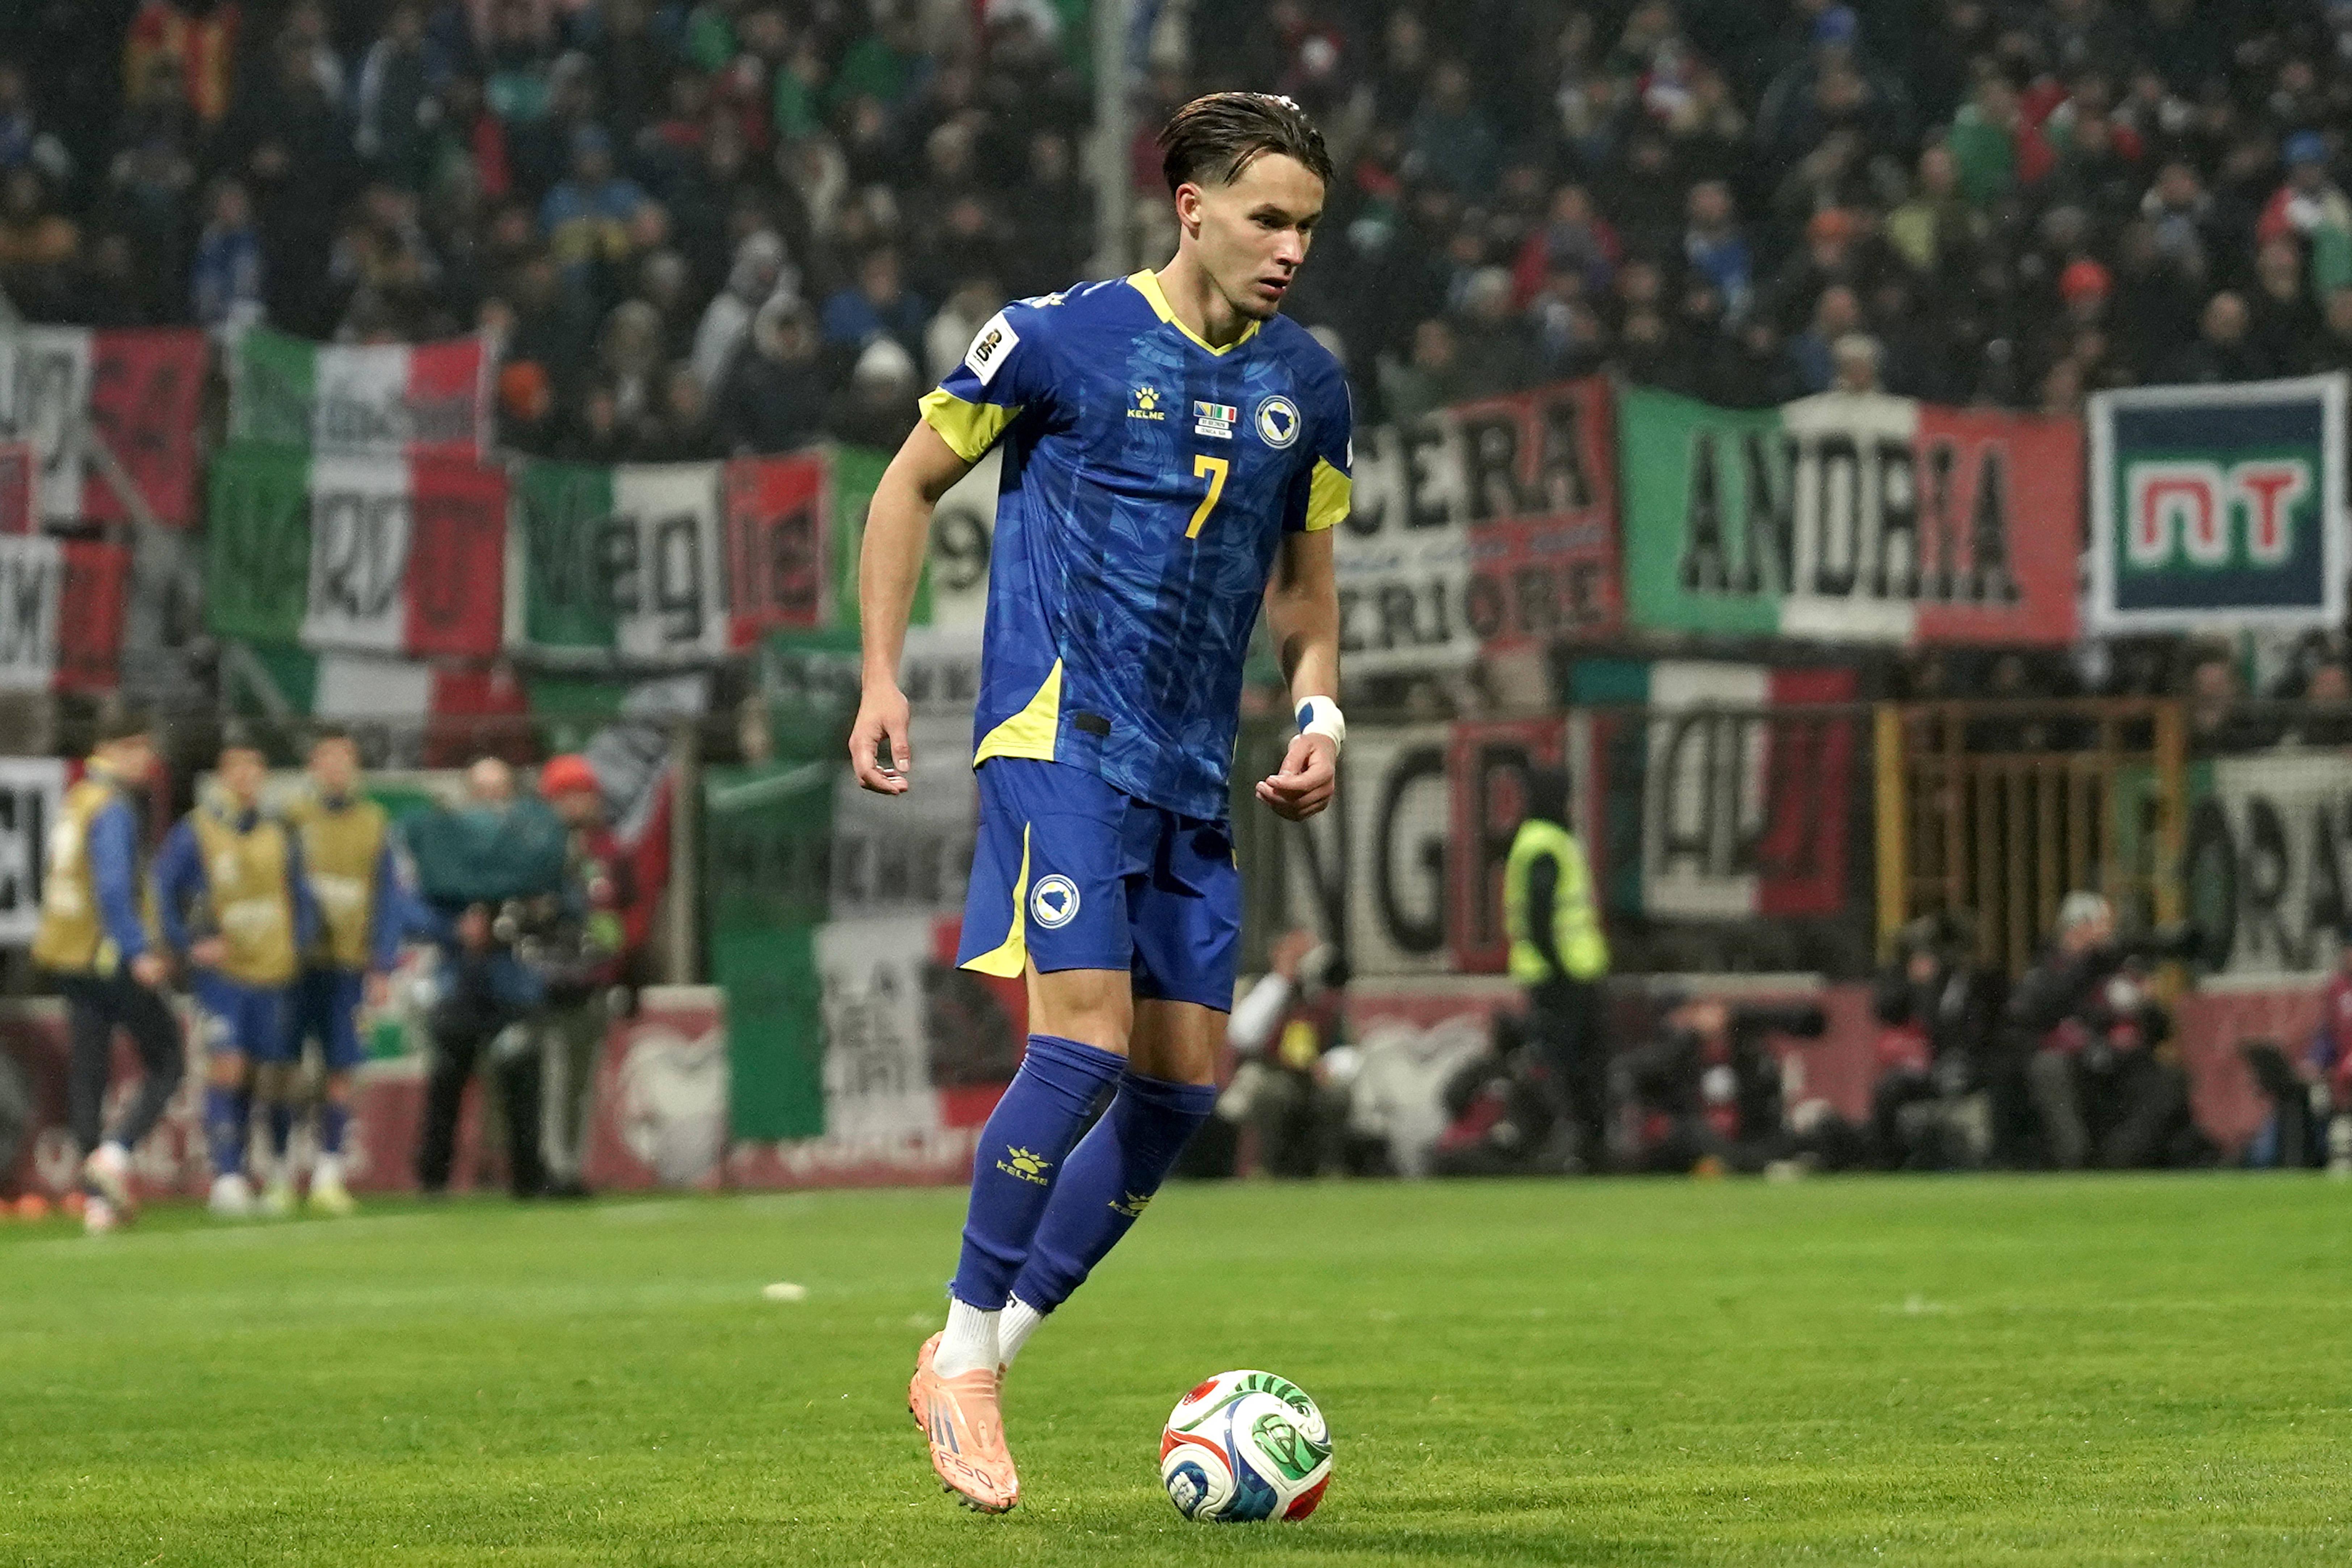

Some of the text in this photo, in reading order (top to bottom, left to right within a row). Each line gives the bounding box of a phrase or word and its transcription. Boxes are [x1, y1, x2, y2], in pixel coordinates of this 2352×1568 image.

[1127, 409, 1165, 420] KELME
[1185, 454, 1229, 539] 7
[1683, 428, 2021, 603] ANDRIA
[996, 1159, 1048, 1186] KELME
[939, 1450, 994, 1489] F50
